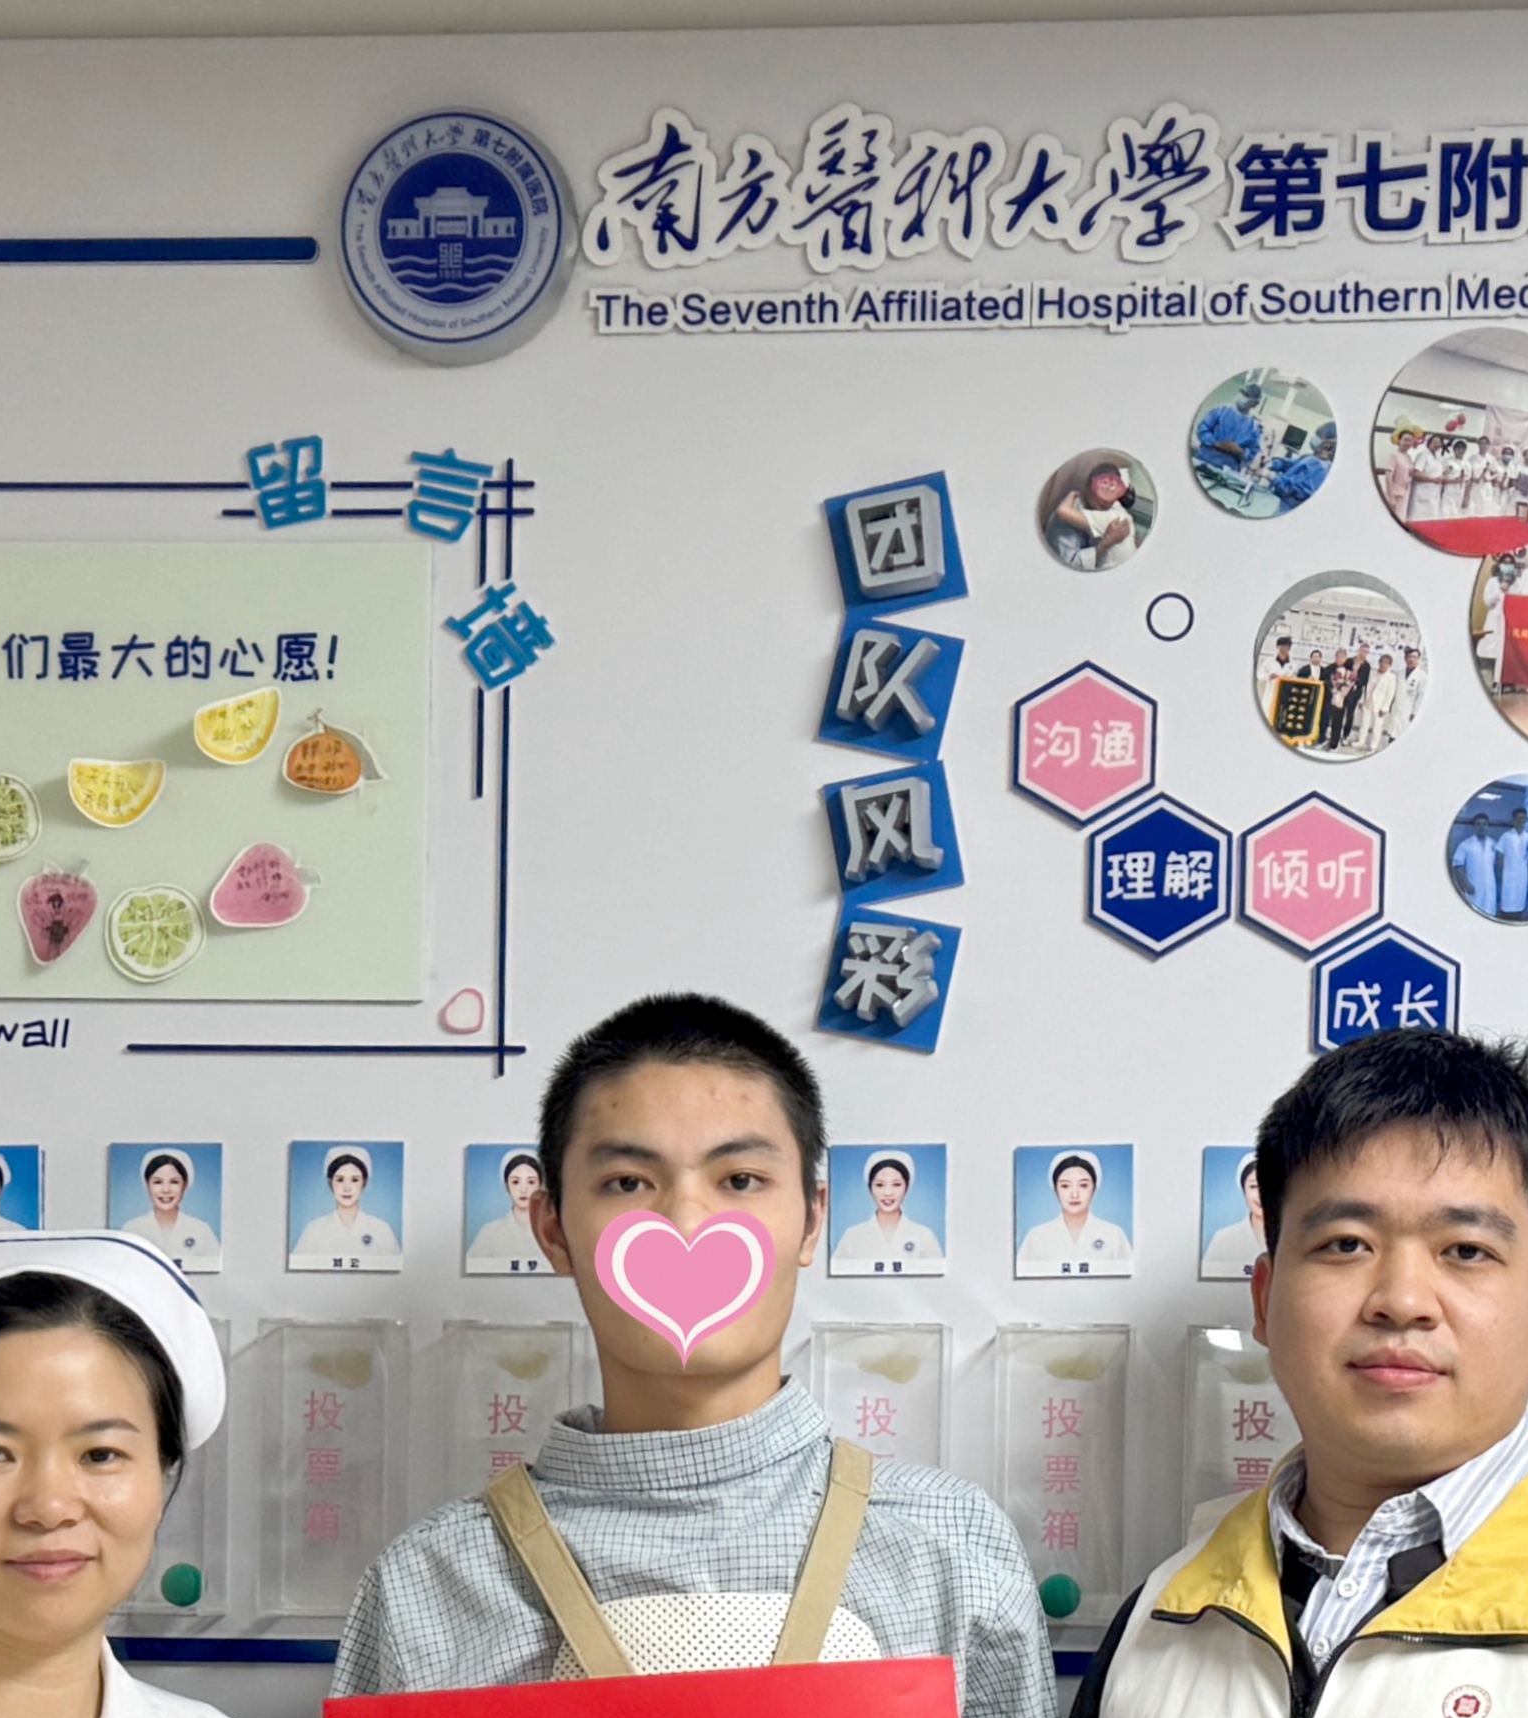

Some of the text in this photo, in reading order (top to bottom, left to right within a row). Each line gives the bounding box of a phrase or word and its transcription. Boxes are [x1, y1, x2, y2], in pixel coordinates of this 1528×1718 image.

[596, 295, 668, 327] The
[681, 292, 840, 326] Seventh
[852, 287, 1025, 321] Affiliated
[1038, 284, 1198, 326] Hospital
[1210, 283, 1249, 317] of
[1260, 279, 1443, 316] Southern
[1032, 719, 1137, 770] 沟通
[1106, 850, 1214, 901] 理解
[1257, 849, 1367, 900] 倾听
[1333, 981, 1440, 1031] 成长
[304, 1390, 344, 1545] 投票箱
[1041, 1397, 1083, 1552] 投票箱
